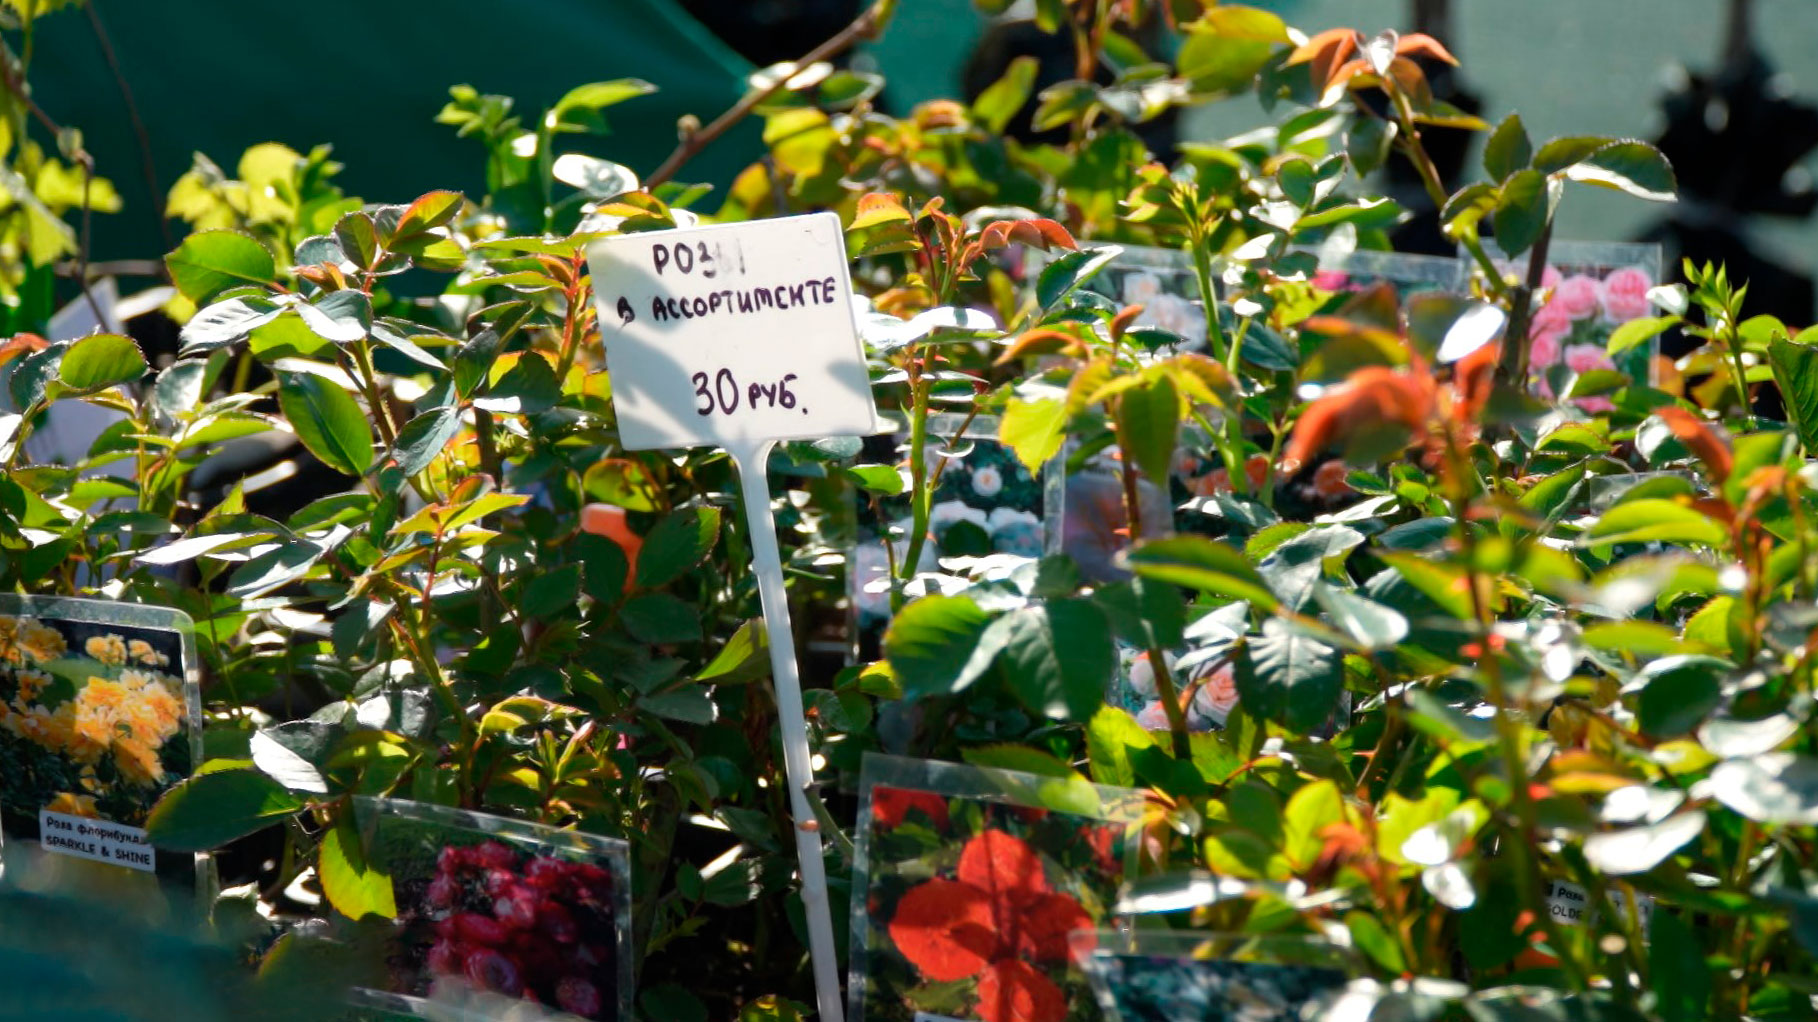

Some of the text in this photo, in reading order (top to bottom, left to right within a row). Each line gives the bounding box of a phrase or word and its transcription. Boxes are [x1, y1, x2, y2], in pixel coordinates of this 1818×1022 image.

[692, 367, 740, 415] 30
[46, 834, 151, 865] SPARKLE & SHINE
[77, 824, 144, 844] флорибунд
